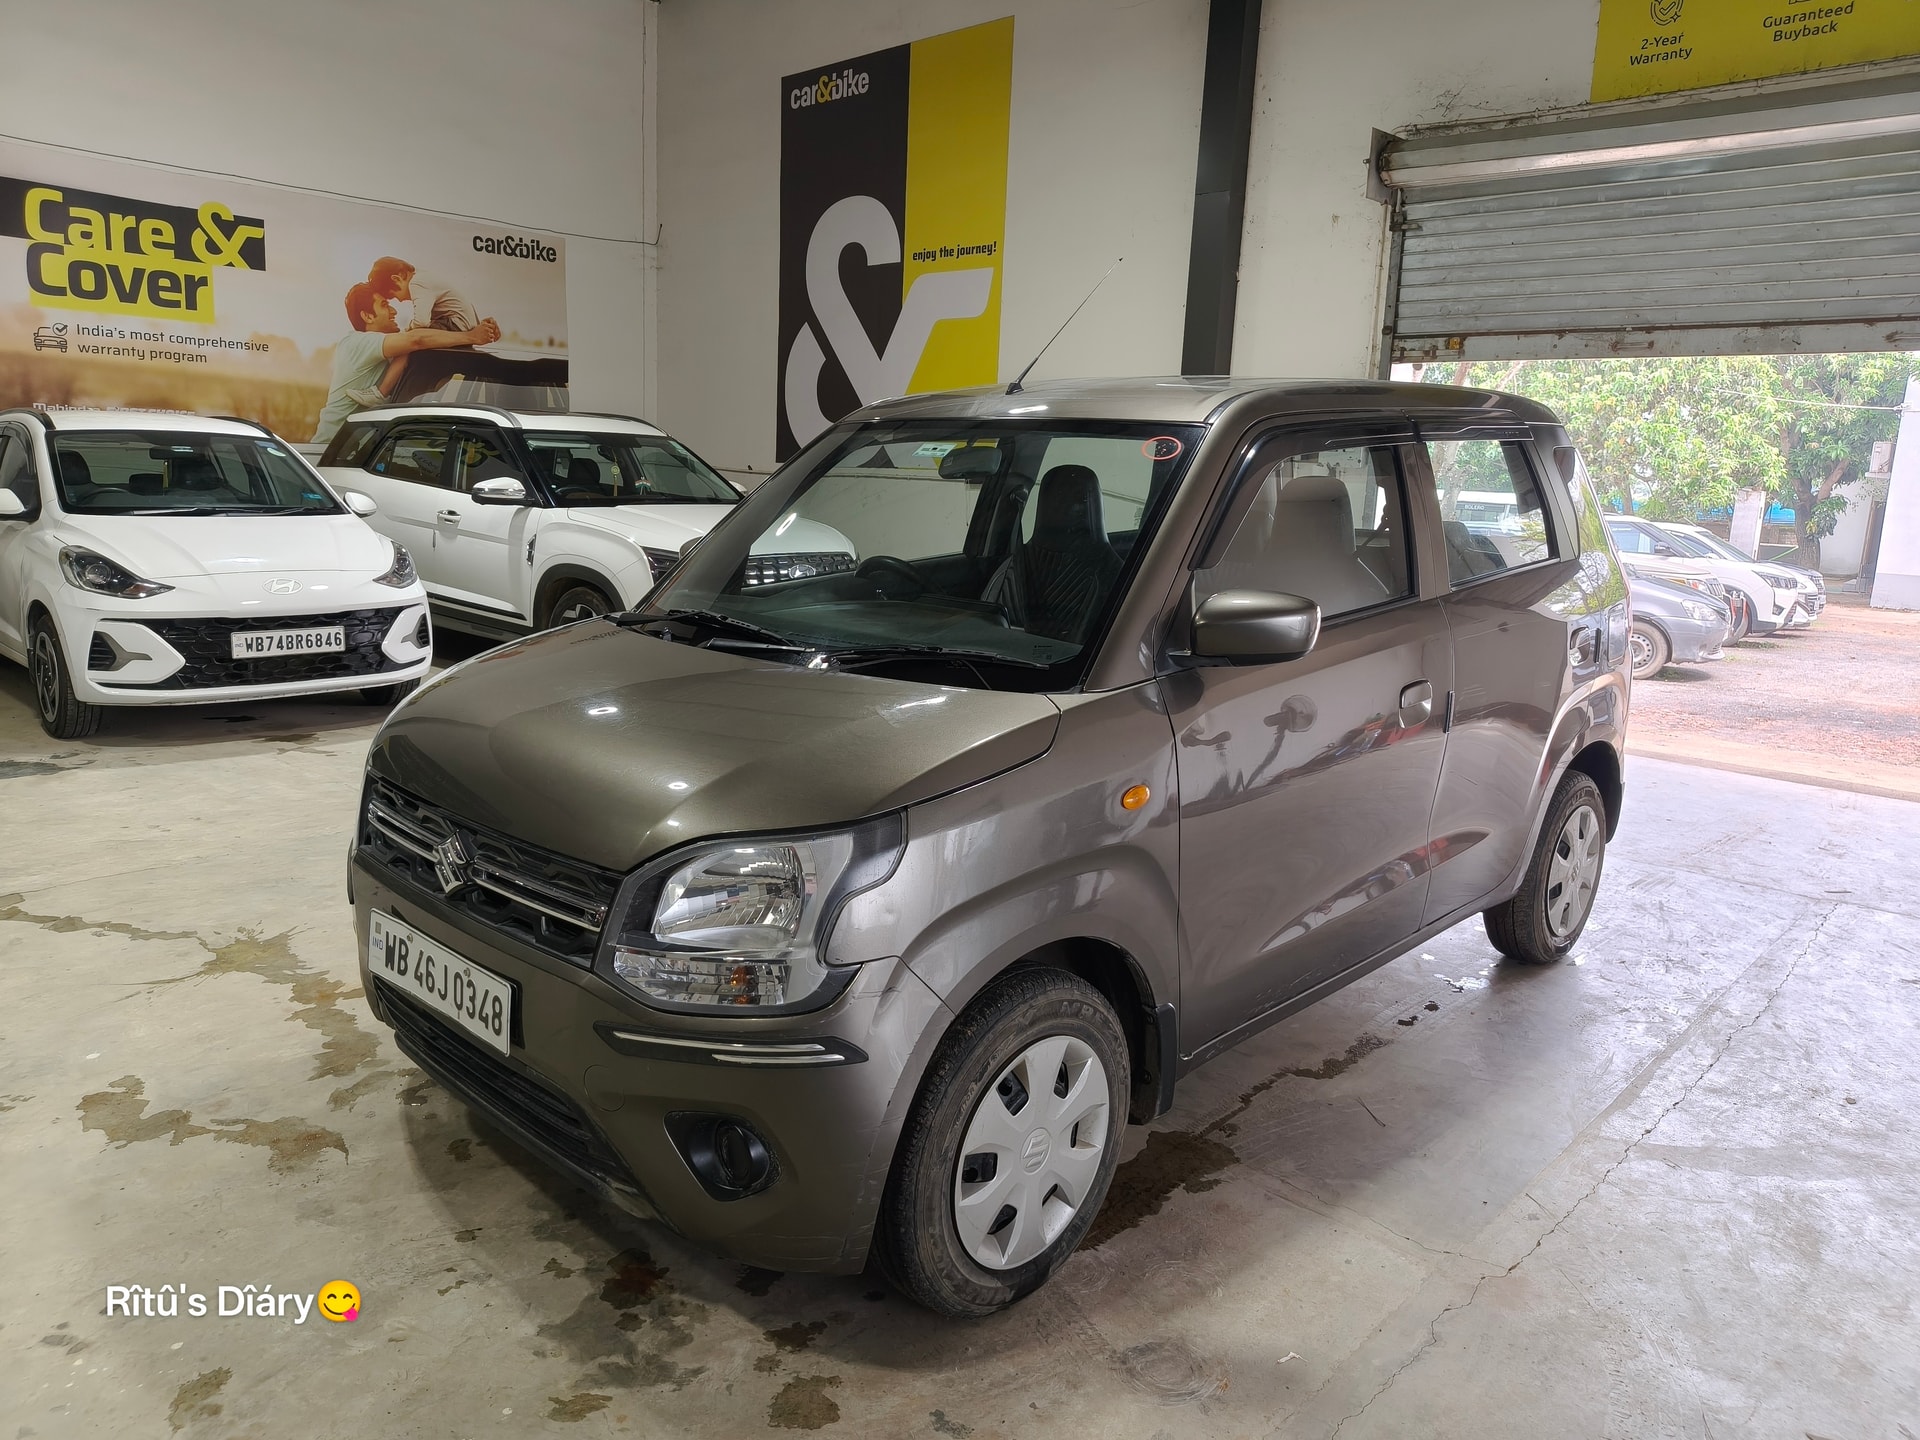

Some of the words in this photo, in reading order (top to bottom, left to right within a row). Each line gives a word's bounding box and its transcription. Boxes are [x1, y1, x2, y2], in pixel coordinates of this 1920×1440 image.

[1763, 1, 1854, 28] Guaranteed
[1641, 32, 1684, 50] 2-Year
[1773, 20, 1838, 42] Buyback
[1630, 47, 1692, 66] Warranty
[790, 69, 870, 109] car&bike
[25, 187, 176, 259] Care
[191, 202, 264, 269] &
[472, 235, 557, 263] car&bike
[912, 248, 937, 263] enjoy
[939, 245, 955, 258] the
[956, 240, 998, 259] journey!
[26, 242, 208, 311] Cover
[77, 324, 125, 339] India's
[130, 331, 165, 343] most
[169, 333, 269, 352] comprehensive
[78, 344, 145, 360] warranty
[150, 349, 207, 363] program
[244, 631, 343, 653] WB74BR6846
